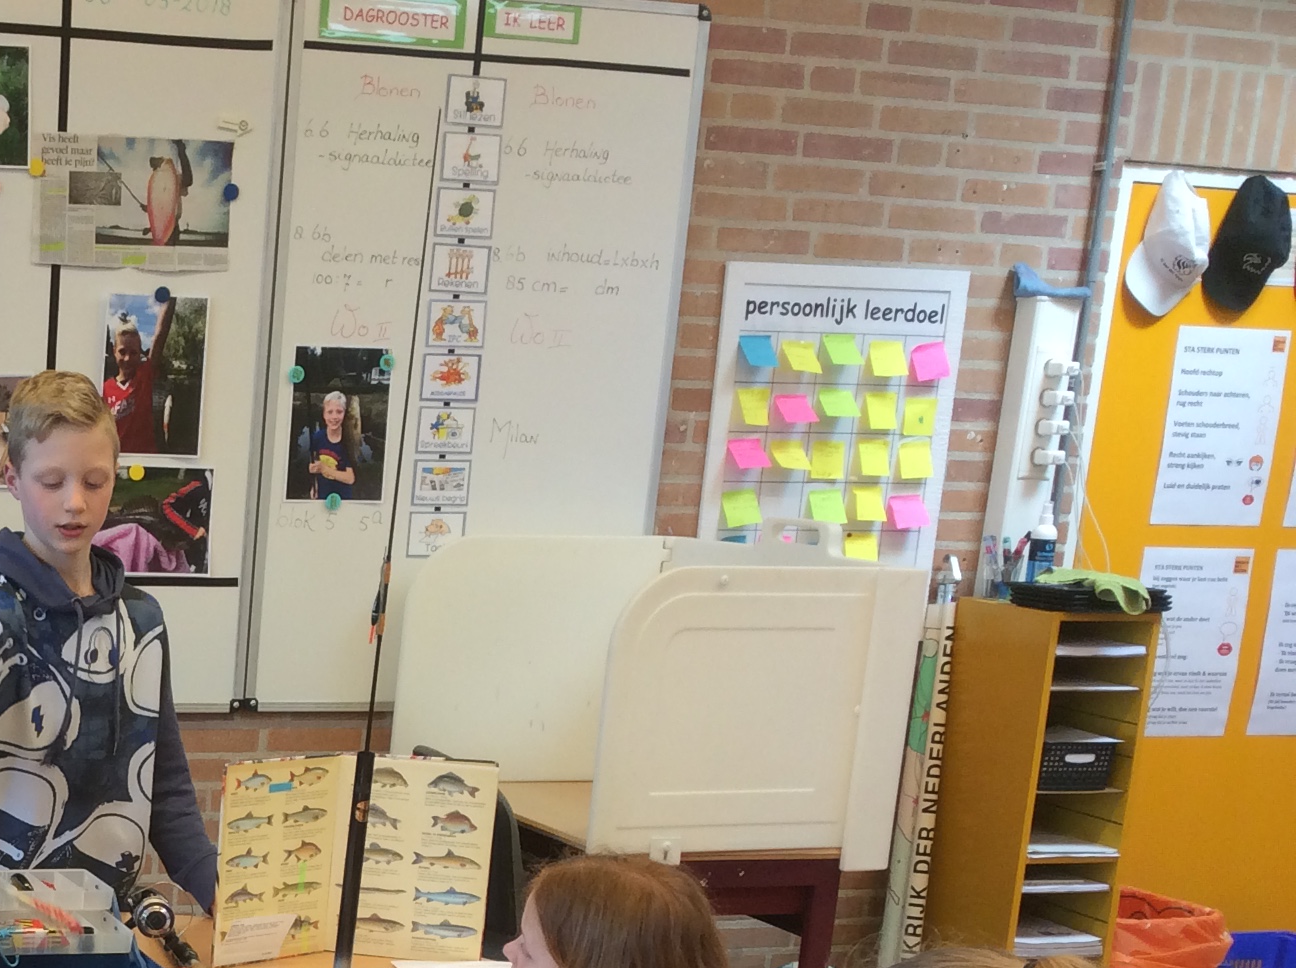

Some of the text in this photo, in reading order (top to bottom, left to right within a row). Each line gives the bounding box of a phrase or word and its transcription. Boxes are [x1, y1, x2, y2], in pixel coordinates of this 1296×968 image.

[342, 6, 449, 30] DAGROOSTER
[504, 12, 566, 31] IK LEER
[347, 122, 420, 148] Herhaling
[544, 141, 610, 166] Herhaling
[321, 245, 364, 263] delen
[369, 250, 398, 265] met
[437, 277, 479, 289] Rekenen
[745, 296, 945, 326] persoonlijk leerdoel
[913, 827, 936, 875] DER
[903, 884, 929, 957] KRIJK
